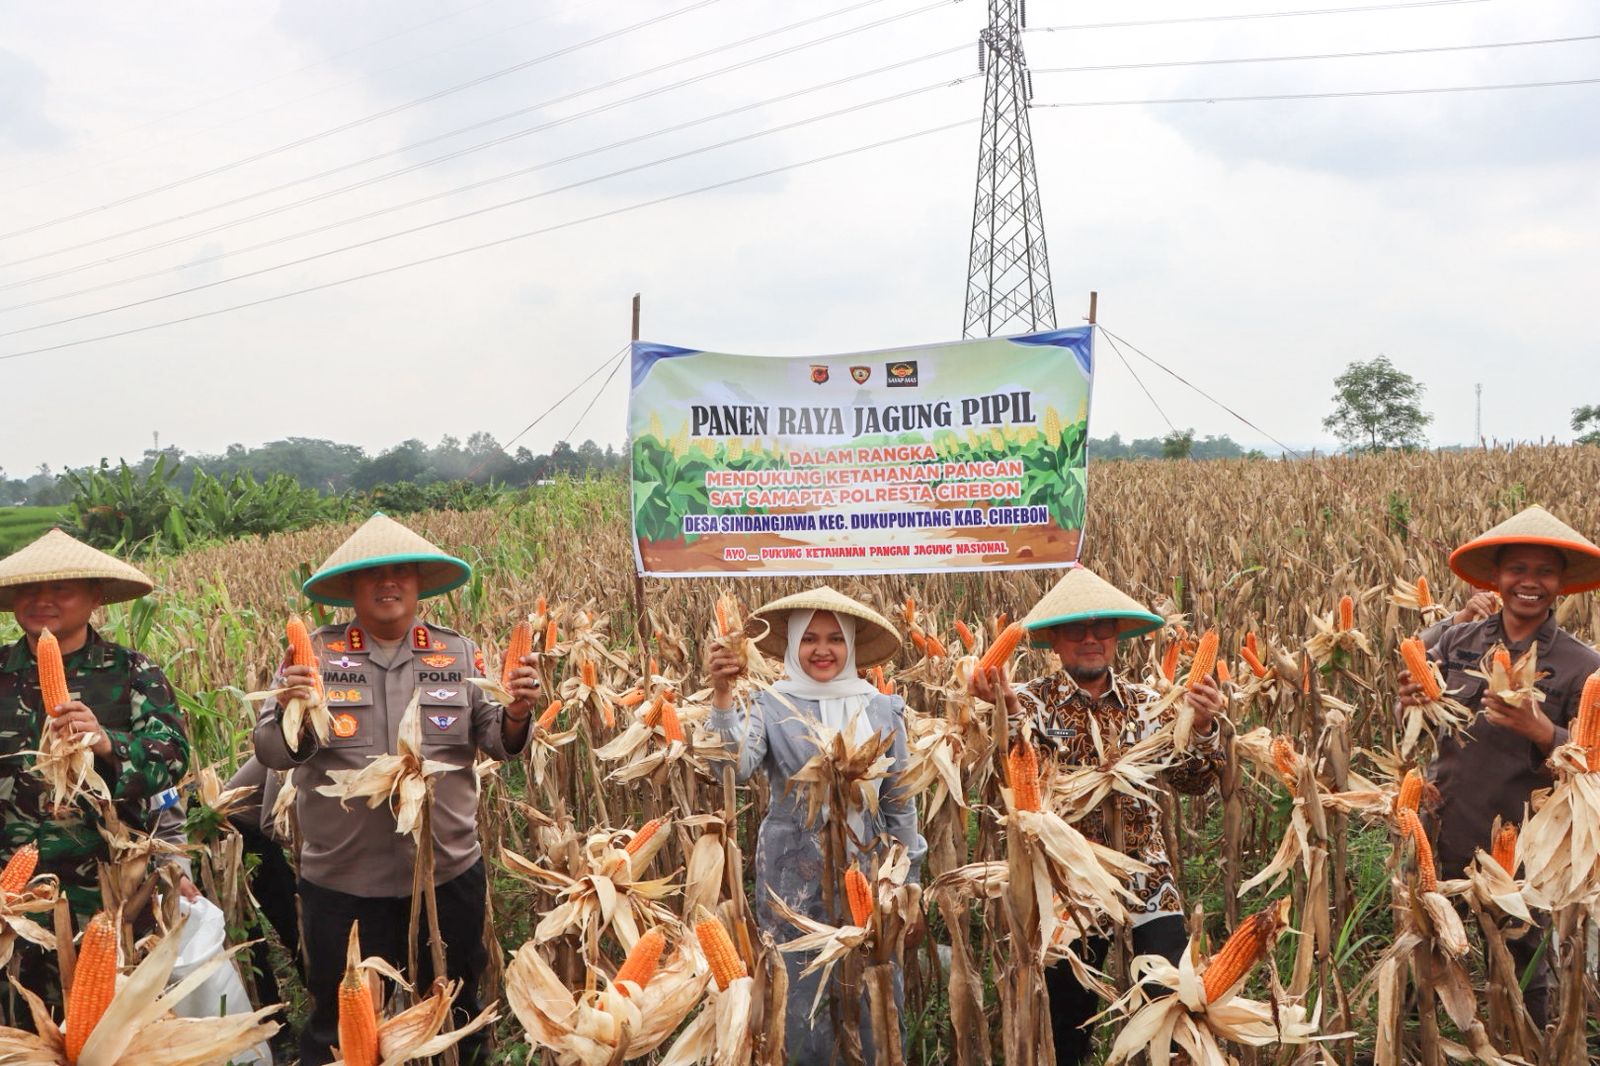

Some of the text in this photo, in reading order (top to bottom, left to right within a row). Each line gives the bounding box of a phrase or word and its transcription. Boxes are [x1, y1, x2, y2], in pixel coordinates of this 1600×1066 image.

[691, 391, 1036, 438] PANEN RAYA JAGUNG PIPIL
[789, 446, 936, 465] DALAM RANGKA
[707, 462, 1022, 486] MENDUKUNG KETAHANAN PANGAN
[710, 482, 1020, 506] SAT SAMAPTA POLRESTA CIREBON
[685, 506, 1048, 532] DESA SINDANGJAWA KEC. DUKUPUNTANG KAB. CIREBON
[725, 548, 746, 560] AYO
[762, 548, 802, 559] DUKUNG
[806, 547, 866, 558] KETAHANAN
[870, 546, 910, 557] PANGAN
[914, 545, 952, 556] JAGUNG
[956, 542, 1007, 554] NASIONAL
[419, 671, 462, 682] POLRI
